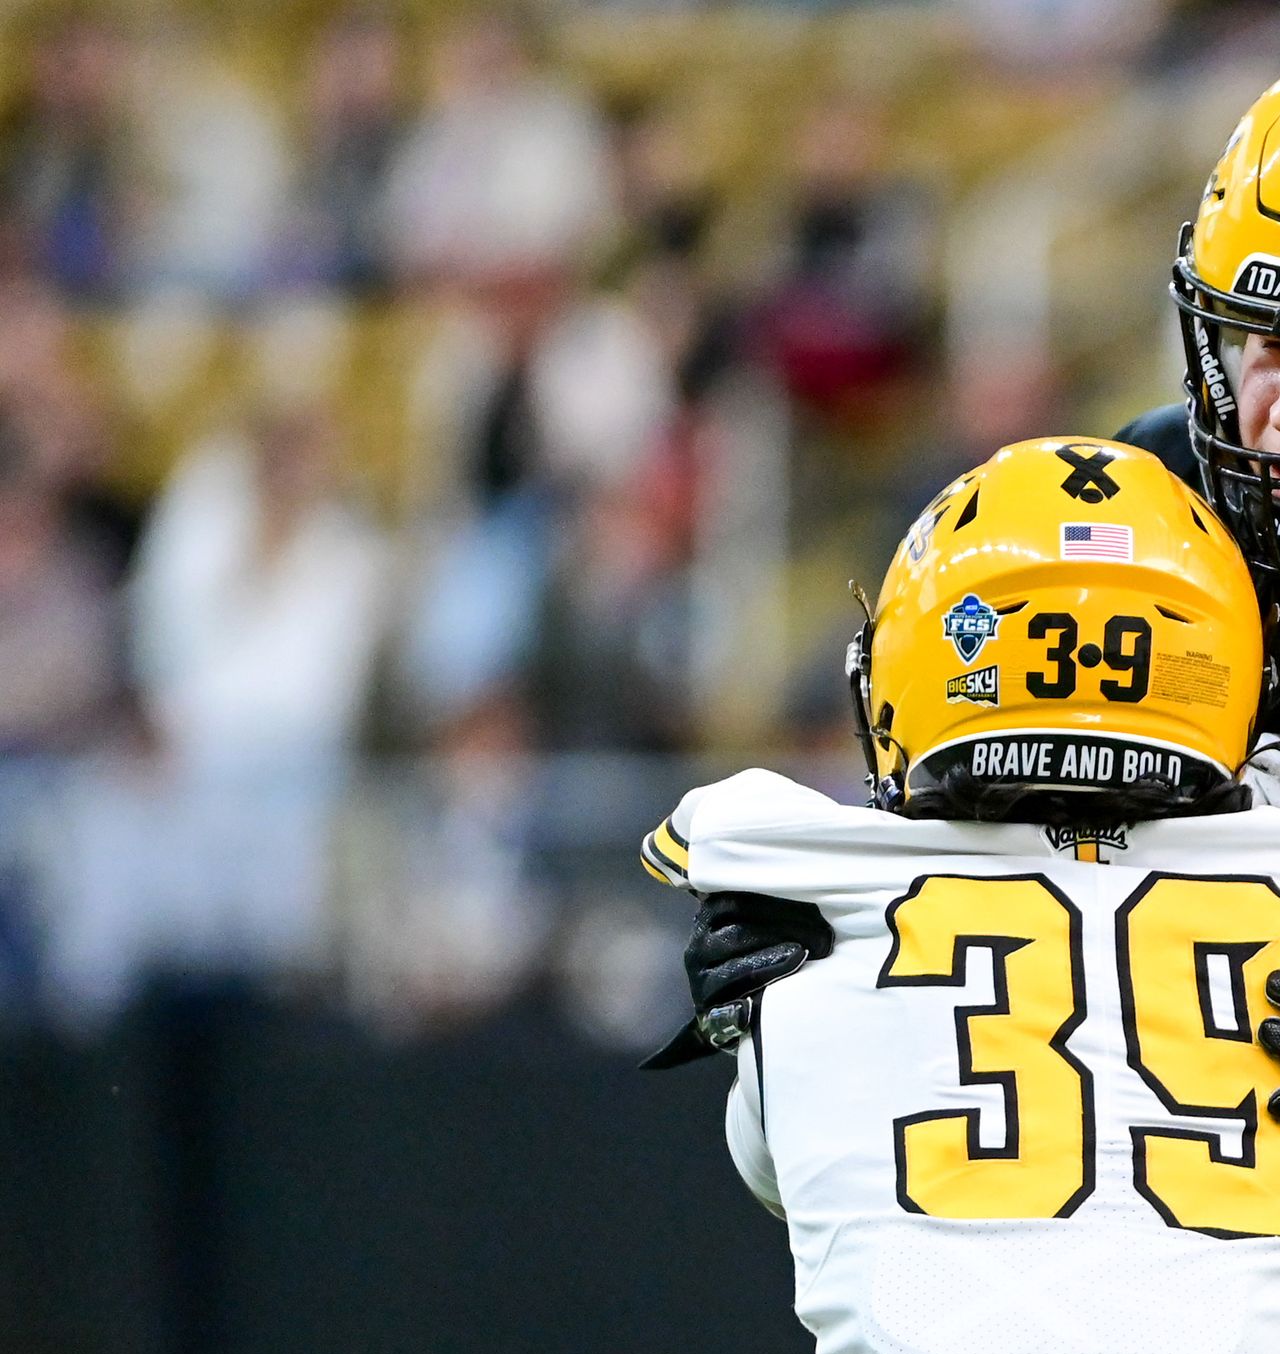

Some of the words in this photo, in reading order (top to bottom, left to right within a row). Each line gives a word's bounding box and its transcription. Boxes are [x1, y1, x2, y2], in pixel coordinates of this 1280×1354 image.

[950, 618, 990, 632] FCS
[971, 742, 1054, 777] BRAVE
[1060, 744, 1114, 781] AND
